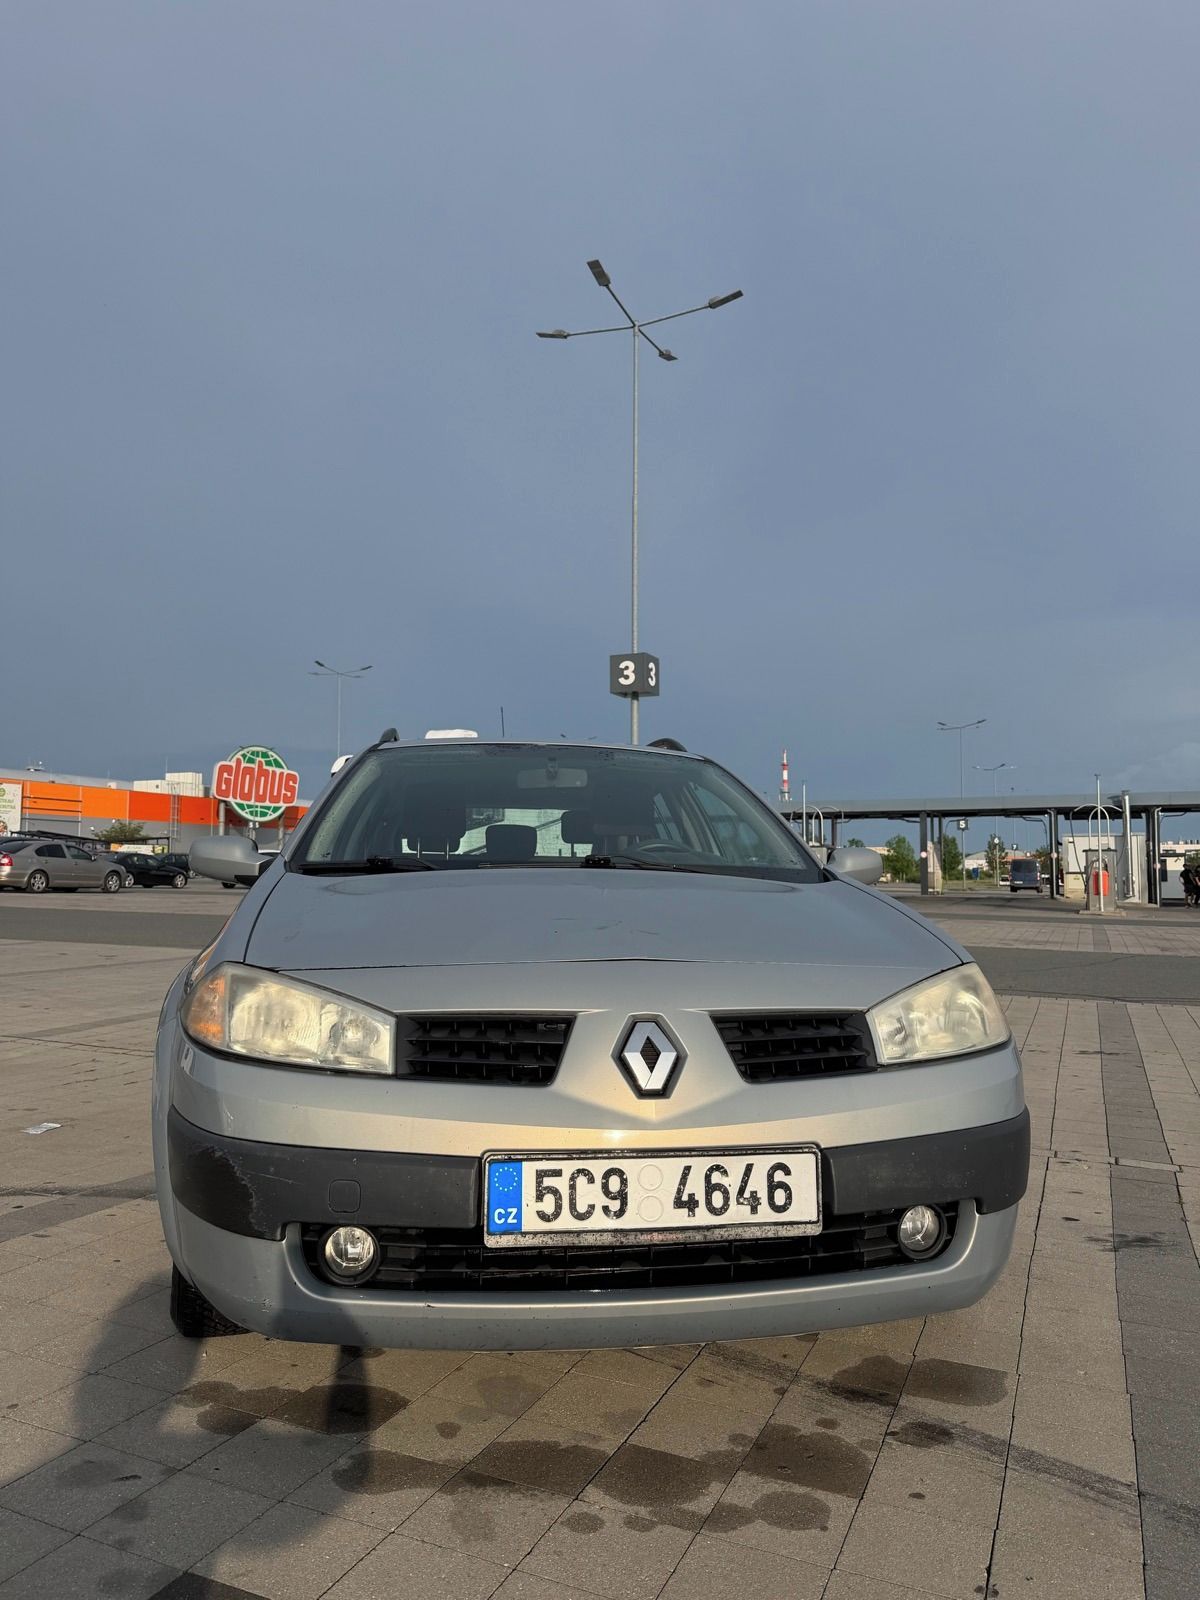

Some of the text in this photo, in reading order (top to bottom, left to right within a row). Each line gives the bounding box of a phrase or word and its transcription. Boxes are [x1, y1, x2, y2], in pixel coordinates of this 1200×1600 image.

[618, 660, 636, 685] 3
[648, 662, 656, 687] 3
[215, 757, 298, 804] Globus
[959, 820, 966, 828] 5
[535, 1162, 793, 1223] 5C9 4646
[494, 1207, 518, 1224] CZ
